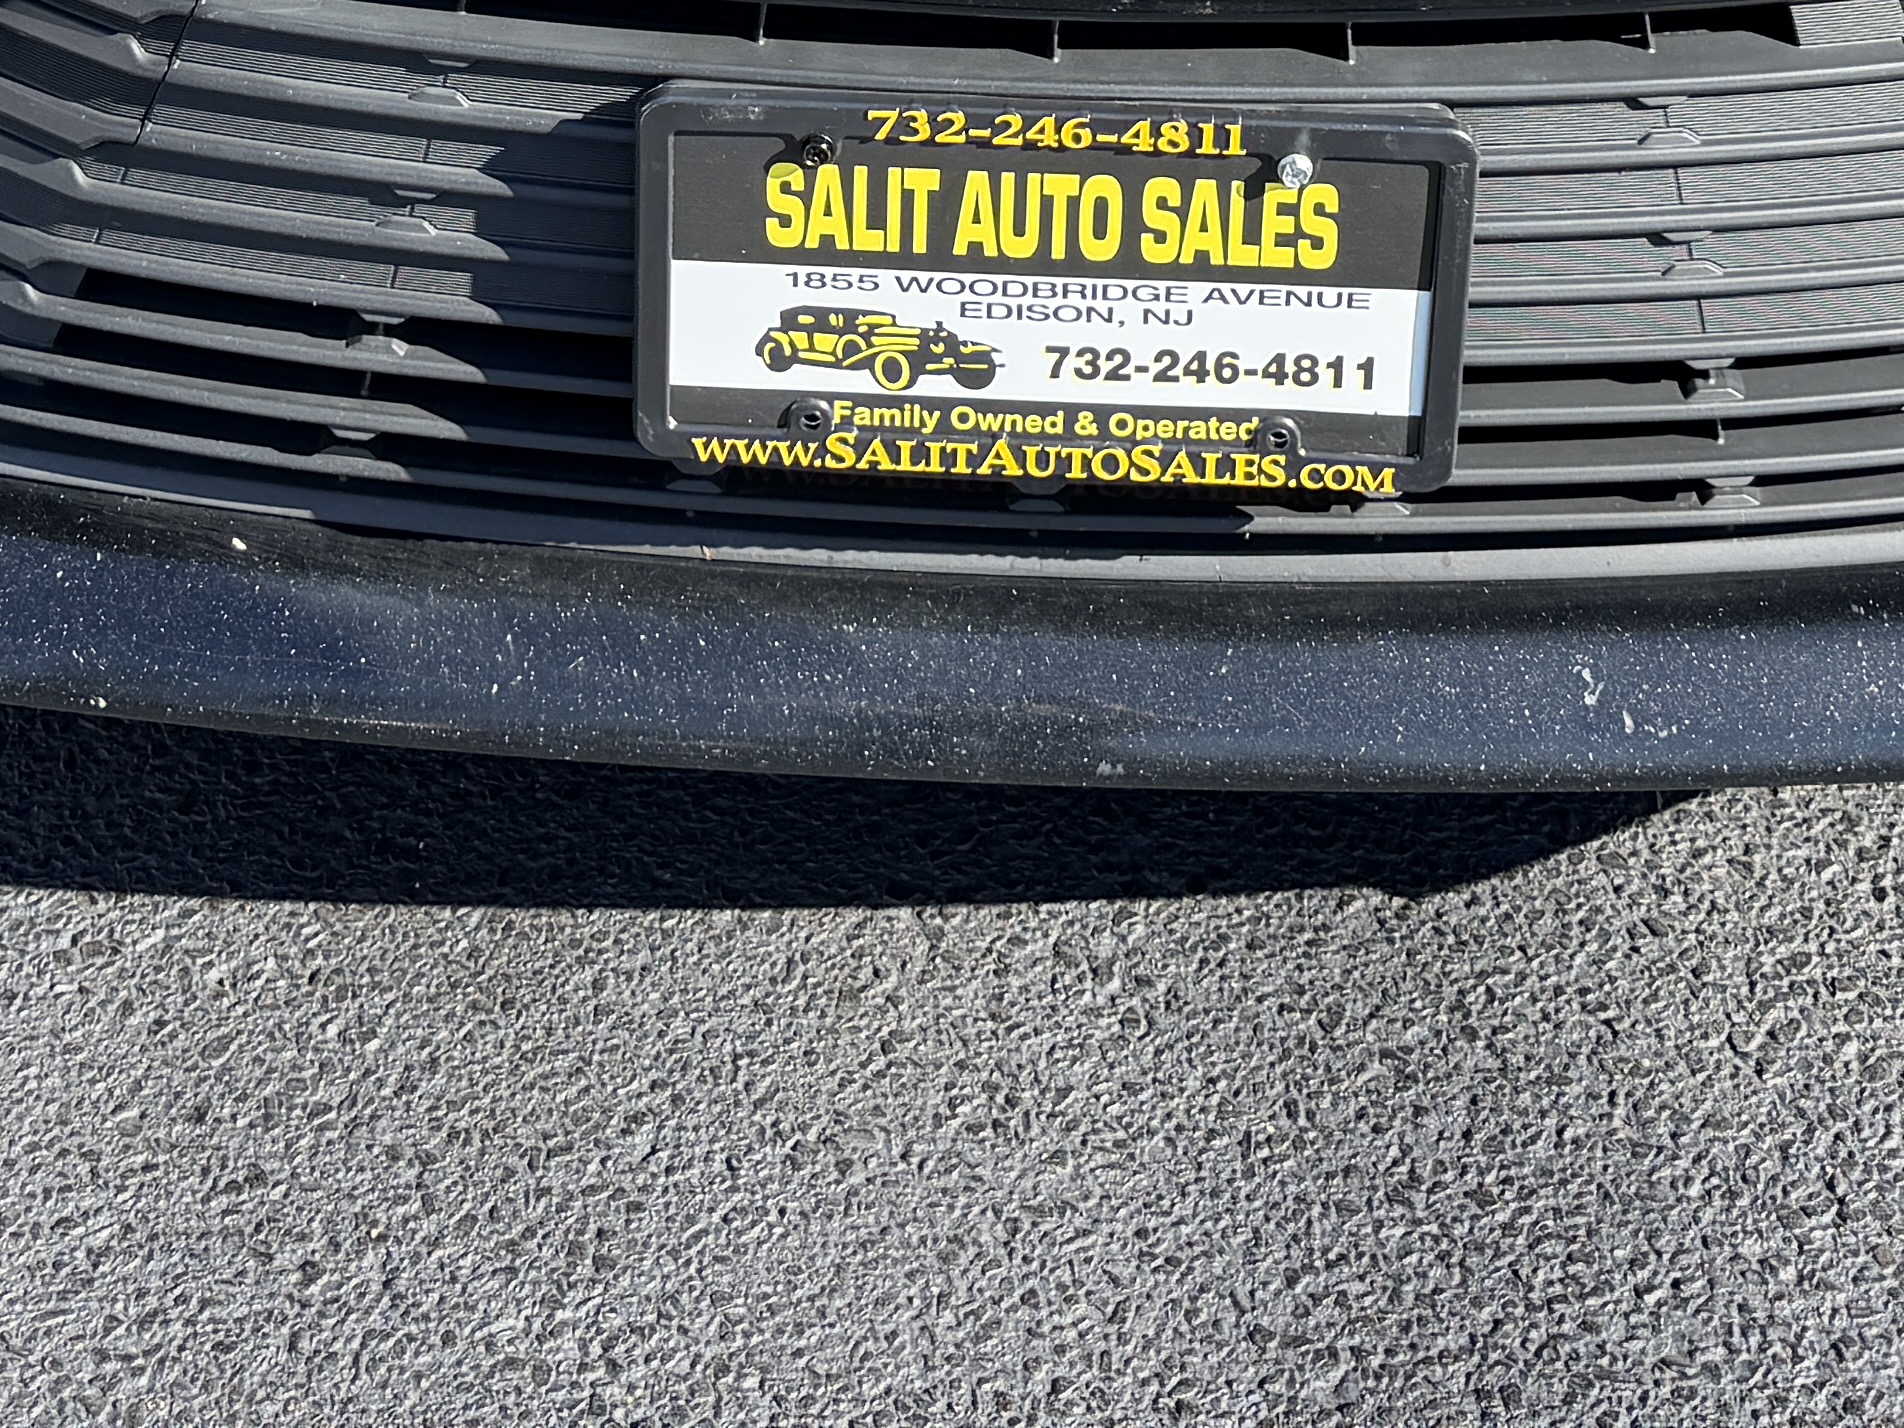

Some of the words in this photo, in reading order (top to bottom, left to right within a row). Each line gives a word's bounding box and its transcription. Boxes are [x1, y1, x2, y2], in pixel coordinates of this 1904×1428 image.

[867, 109, 1246, 156] 732-246-4811
[765, 162, 941, 254] SALIT
[952, 170, 1123, 262] AUTO
[1140, 176, 1340, 270] SALES
[785, 271, 880, 291] 1855
[894, 275, 1192, 304] WOODBRIDGE
[1201, 287, 1373, 310] AVENUE
[959, 301, 1126, 328] EDISON,
[1142, 308, 1194, 326] NJ
[1044, 345, 1376, 390] 732-246-4811
[832, 400, 942, 434] Family
[950, 405, 1065, 435] Owned
[1074, 410, 1099, 437] &
